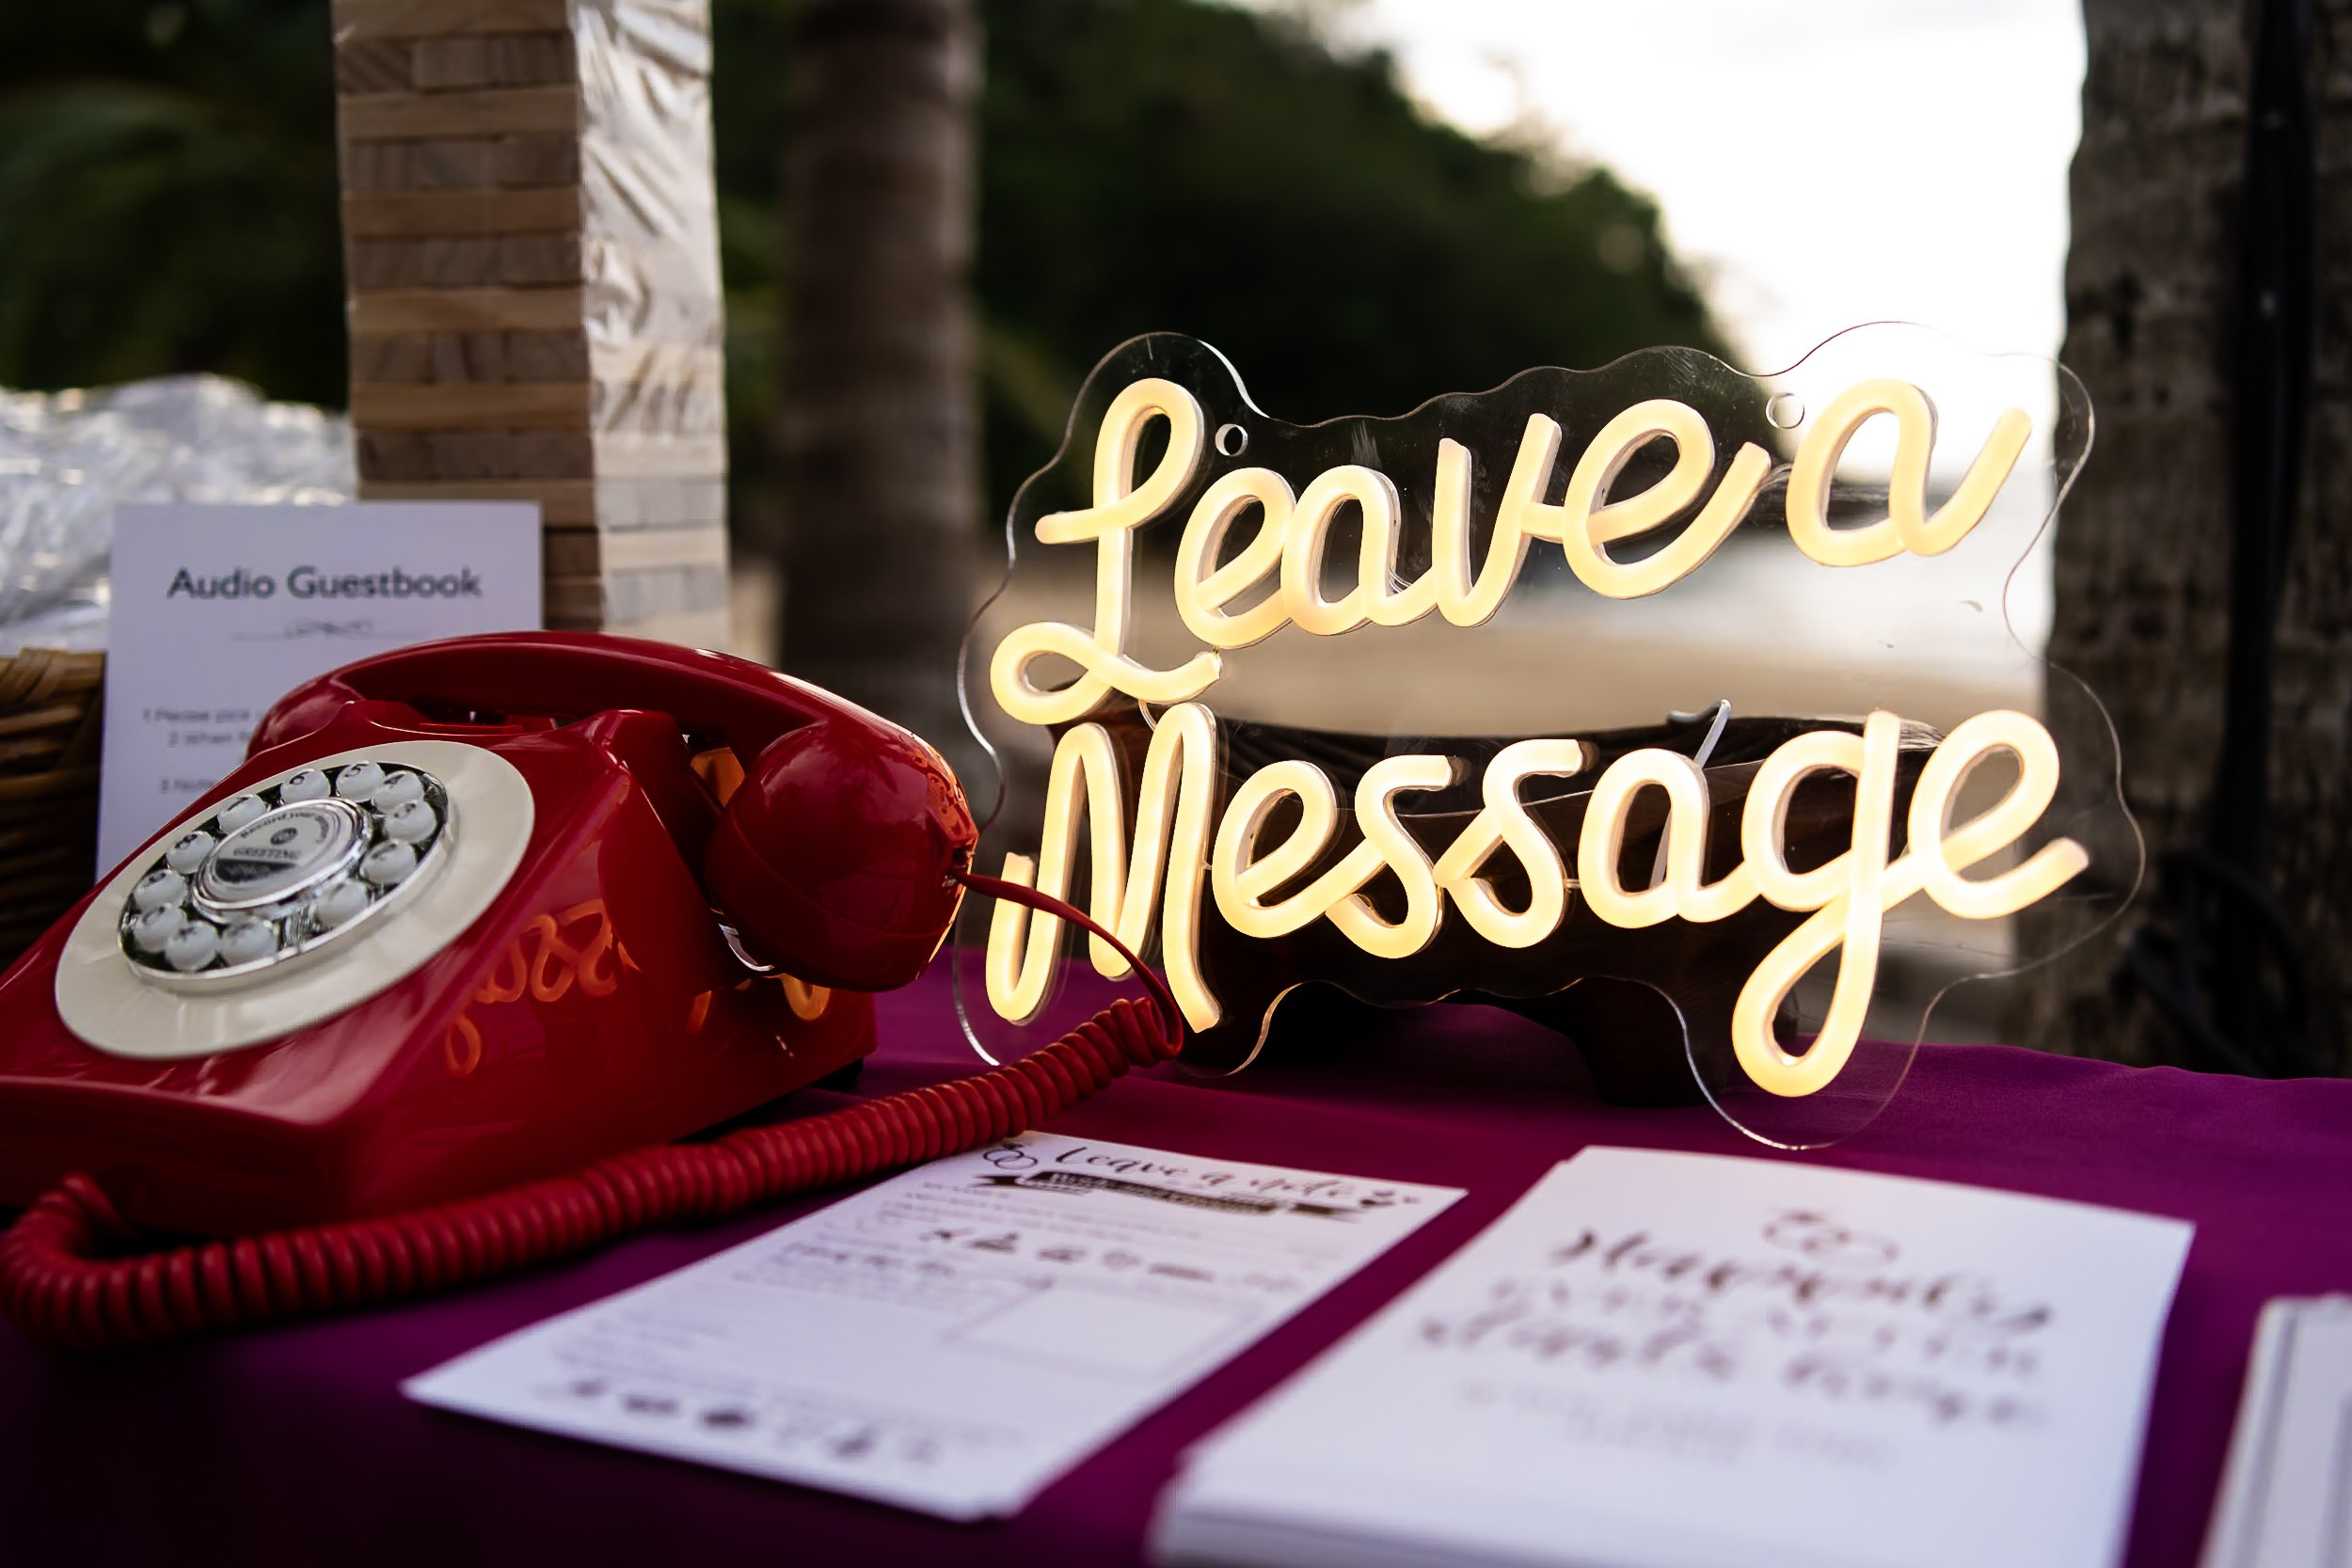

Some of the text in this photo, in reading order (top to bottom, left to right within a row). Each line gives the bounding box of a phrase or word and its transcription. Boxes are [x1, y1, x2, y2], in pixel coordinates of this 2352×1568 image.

[989, 377, 2032, 725] Leave a
[167, 565, 484, 600] Audio Guestbook
[289, 771, 310, 786] 6
[344, 763, 369, 778] 5
[986, 702, 2090, 1098] Message
